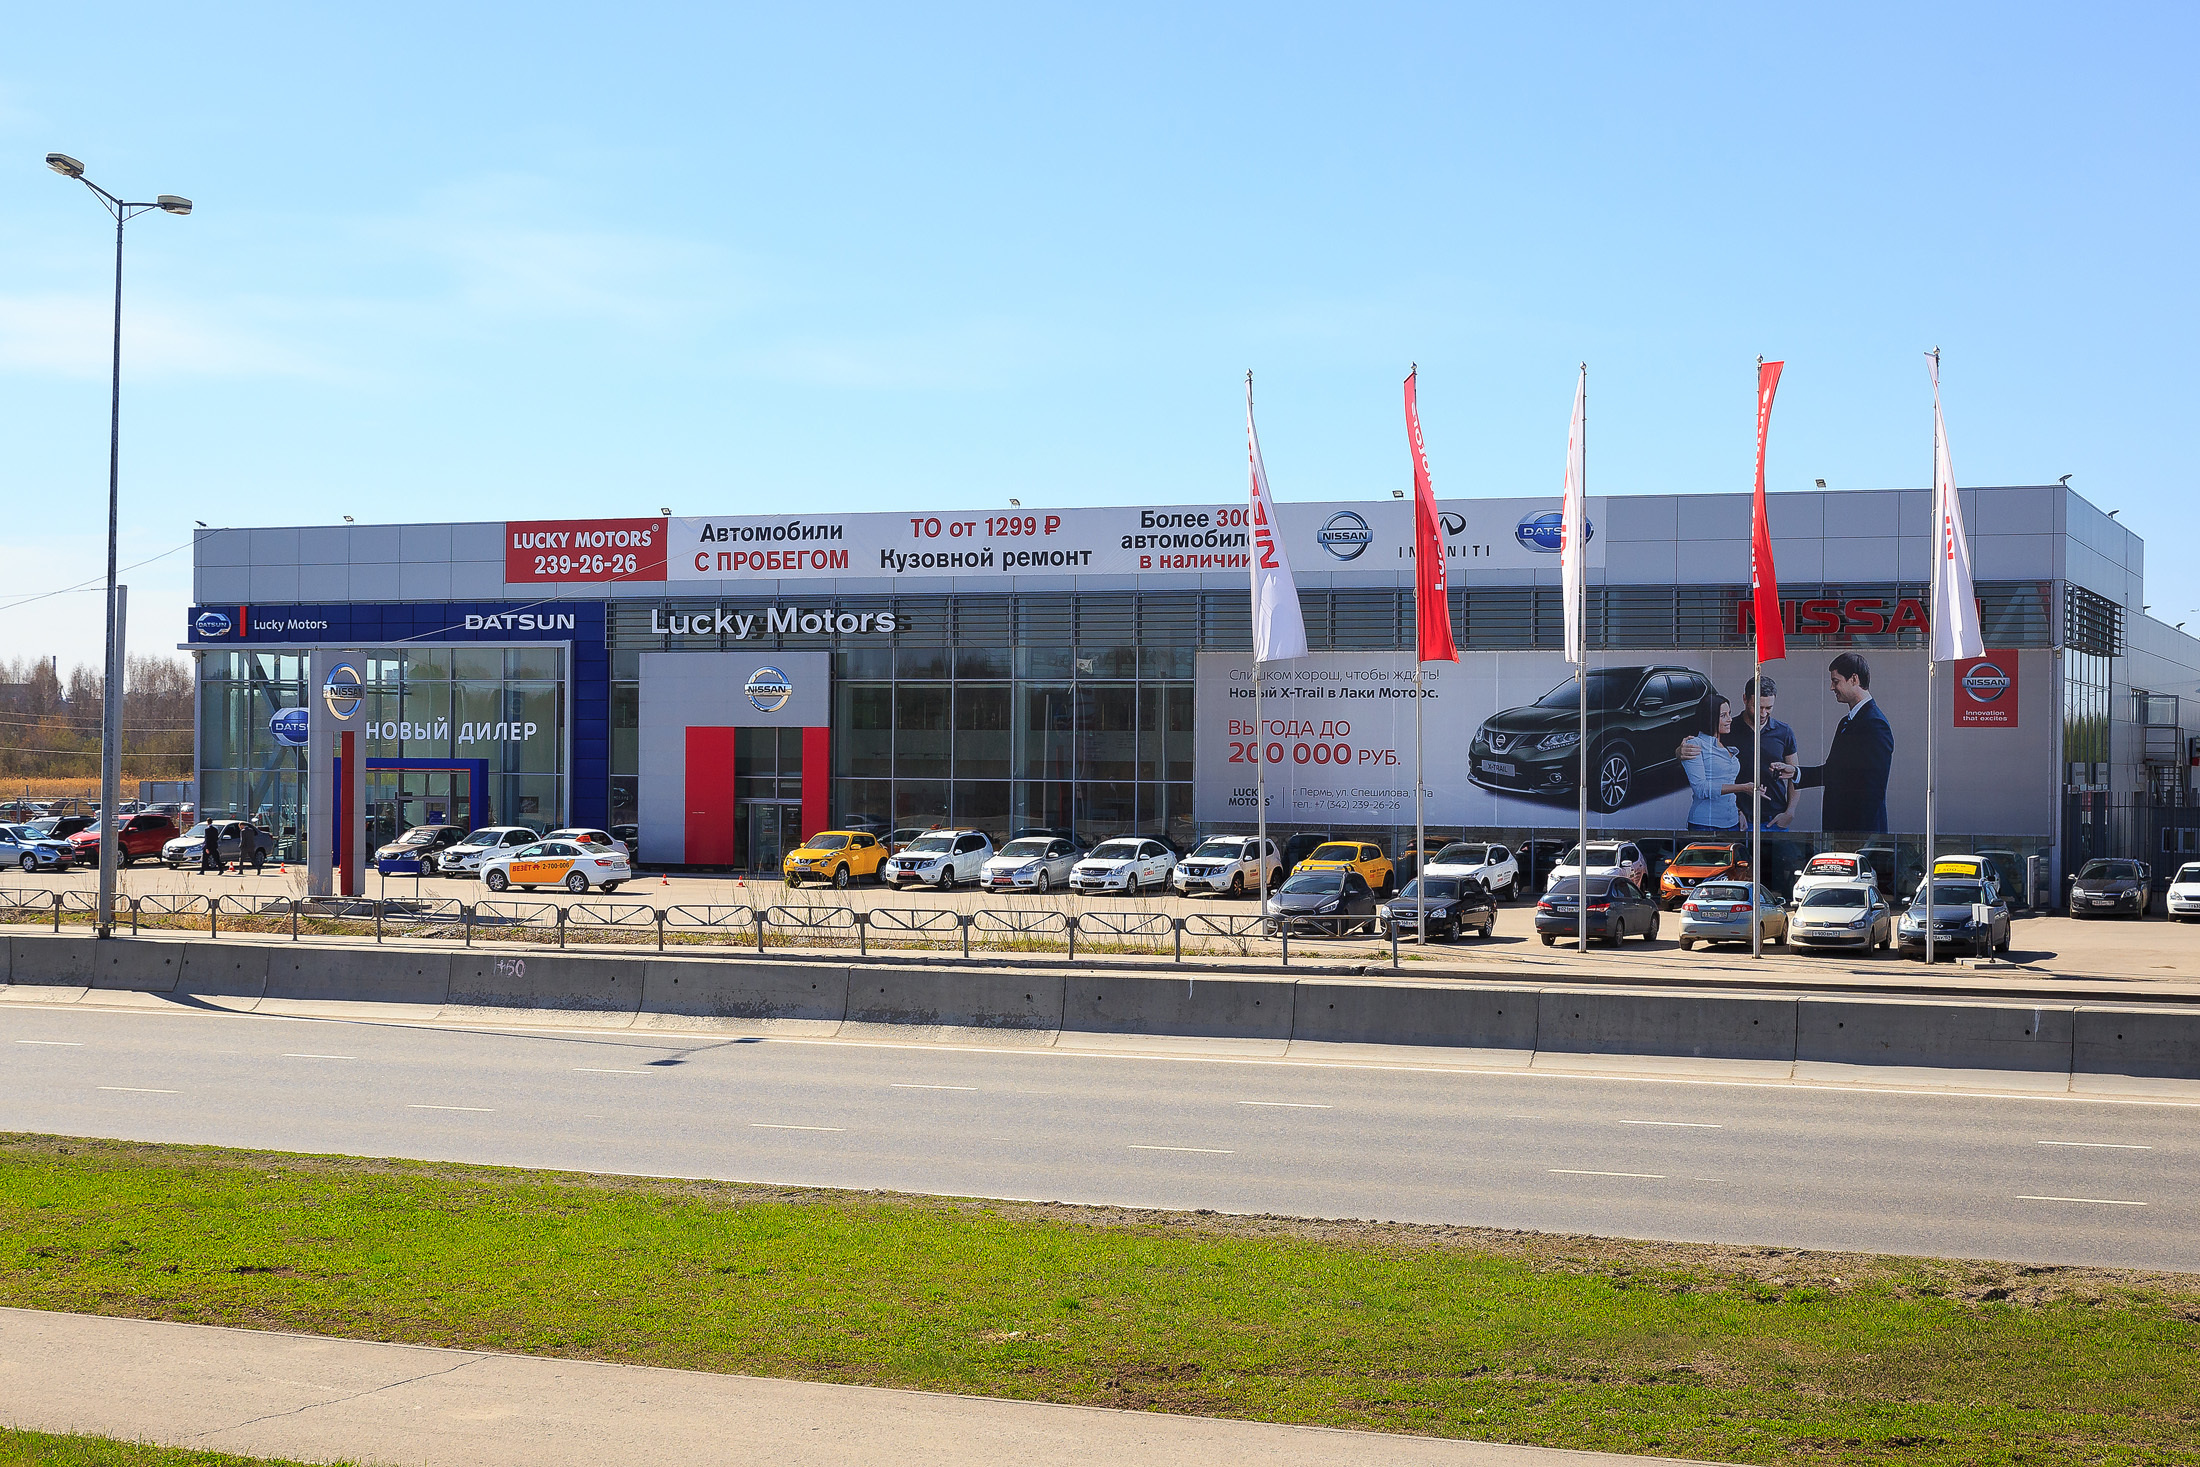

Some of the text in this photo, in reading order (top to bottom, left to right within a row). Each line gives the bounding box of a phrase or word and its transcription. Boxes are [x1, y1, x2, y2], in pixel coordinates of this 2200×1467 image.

[1141, 511, 1209, 528] Более
[700, 520, 843, 543] Автомобили
[910, 517, 942, 538] ТО
[949, 522, 976, 537] от
[984, 516, 1037, 536] 1299
[1523, 527, 1562, 536] DATS
[513, 530, 652, 549] LUCKY MOTORS
[1322, 531, 1368, 541] NISSAN
[1399, 545, 1490, 558] INNITI
[534, 554, 637, 574] 239-26-26
[694, 549, 849, 572] С ПРОБЕГОМ
[880, 547, 1093, 573] Кузовной ремонт
[1139, 555, 1152, 569] в
[254, 619, 328, 632] Lucky Motors
[465, 614, 575, 630] DATSUN
[651, 607, 896, 640] Lucky Motors
[1294, 670, 1343, 683] хорош,
[1345, 668, 1390, 680] чтобы
[748, 685, 786, 694] NISSAN
[1280, 686, 1324, 698] X-Trail
[1328, 689, 1336, 698] в
[1339, 688, 1375, 698] Лаки
[275, 723, 309, 732] DATS
[366, 716, 537, 744] НОВЫЙ ДИЛЕР
[1228, 720, 1351, 739] ВЫГОДА ДО
[1228, 742, 1401, 765] 200 000 РУБ.
[1487, 763, 1508, 773] X-TRAIL
[1233, 788, 1259, 796] LUCK
[1300, 787, 1334, 798] Пермь,
[1335, 789, 1349, 798] ул.
[1350, 788, 1411, 798] Спешилова,
[1228, 798, 1270, 806] MOTOS
[1327, 800, 1350, 809] (342)
[1352, 800, 1401, 809] 239-26-26
[512, 864, 532, 872] ВЕЗЁТ
